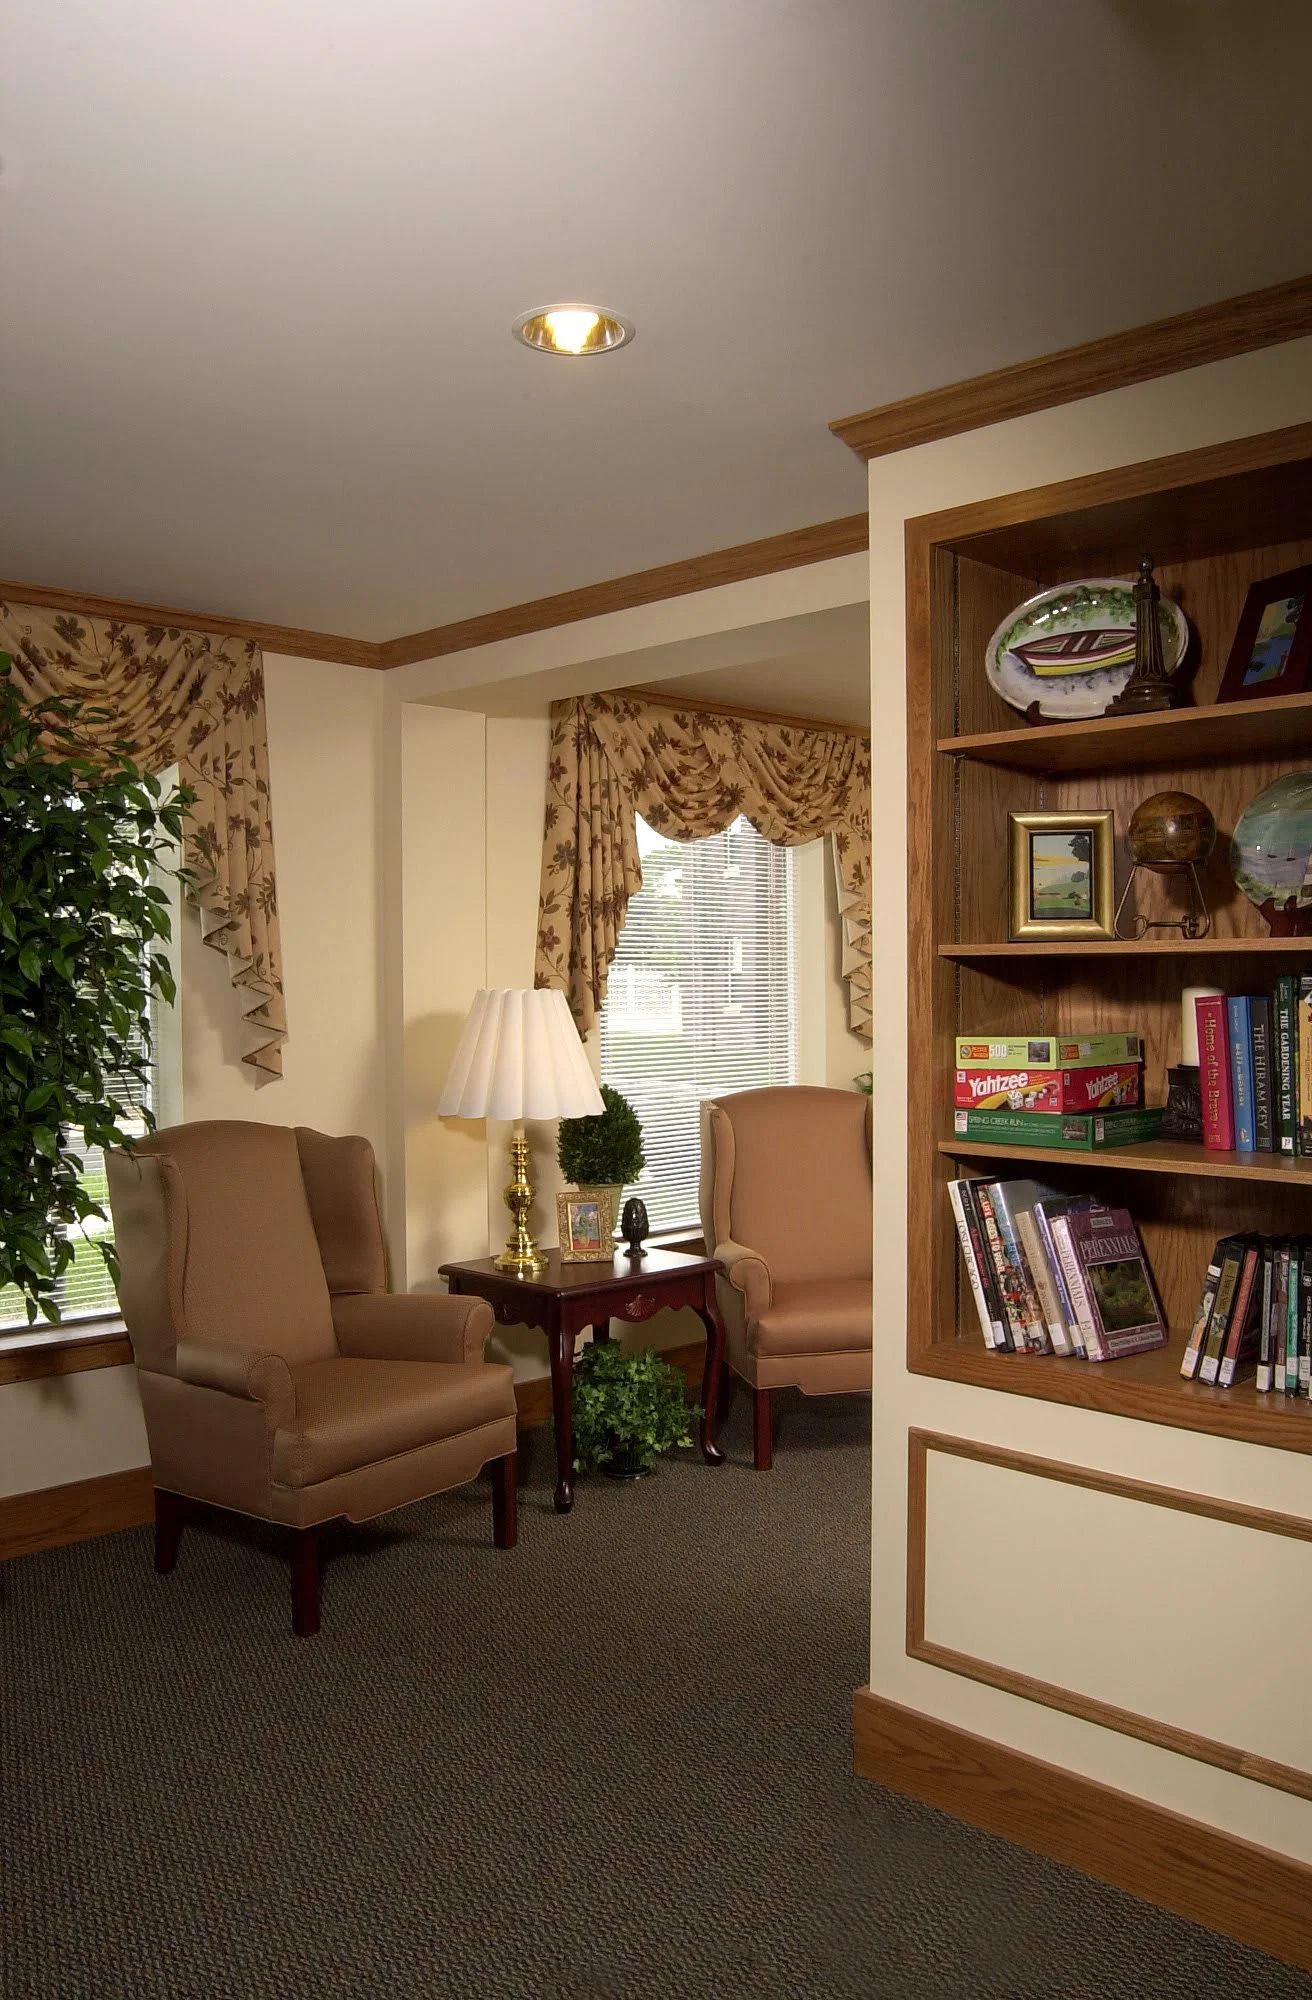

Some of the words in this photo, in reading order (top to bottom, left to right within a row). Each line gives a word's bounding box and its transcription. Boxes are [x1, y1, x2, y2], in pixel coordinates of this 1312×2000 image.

[1280, 1009, 1288, 1029] THE
[1205, 1019, 1217, 1051] Home
[1254, 1024, 1264, 1051] THE
[1207, 1055, 1218, 1067] of
[1281, 1033, 1289, 1090] GARDENING
[968, 1072, 1028, 1097] Yahtzee
[1085, 1072, 1119, 1100] Yahtzee
[1208, 1070, 1219, 1086] the
[1255, 1056, 1267, 1101] HIRAM
[1257, 1105, 1268, 1129] KEY
[1282, 1095, 1290, 1120] YEAR
[1080, 1236, 1139, 1260] PERENNIALS
